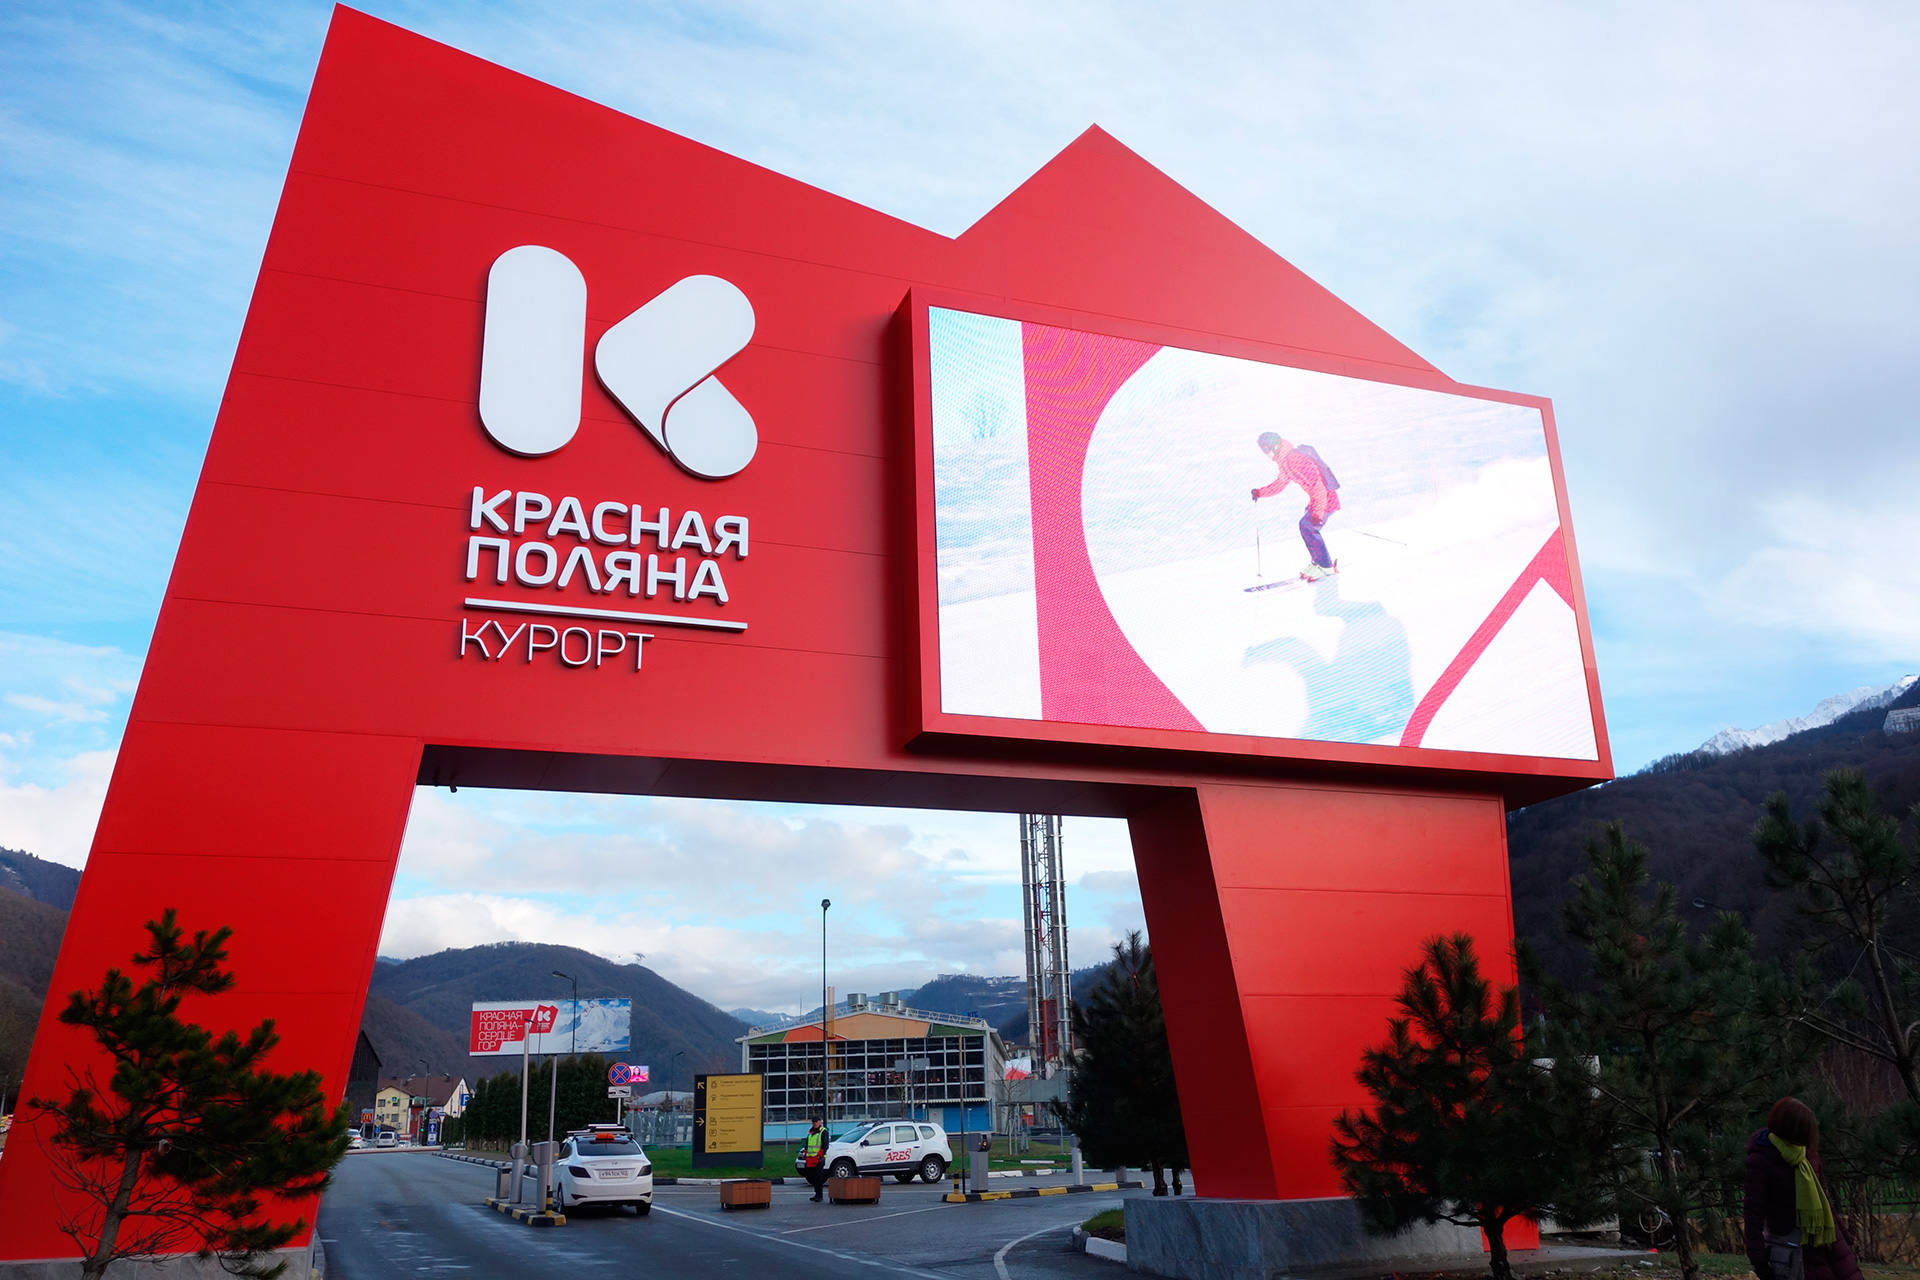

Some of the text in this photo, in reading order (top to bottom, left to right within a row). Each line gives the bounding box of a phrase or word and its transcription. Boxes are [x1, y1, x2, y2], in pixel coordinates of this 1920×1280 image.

[470, 486, 749, 558] КРАСНАЯ
[466, 536, 729, 604] ПОЛЯНА
[460, 618, 655, 672] КУРОРТ
[480, 1011, 523, 1021] КРАСНАЯ
[477, 1041, 497, 1051] ГОР
[478, 1031, 516, 1041] СЕРДЦЕ
